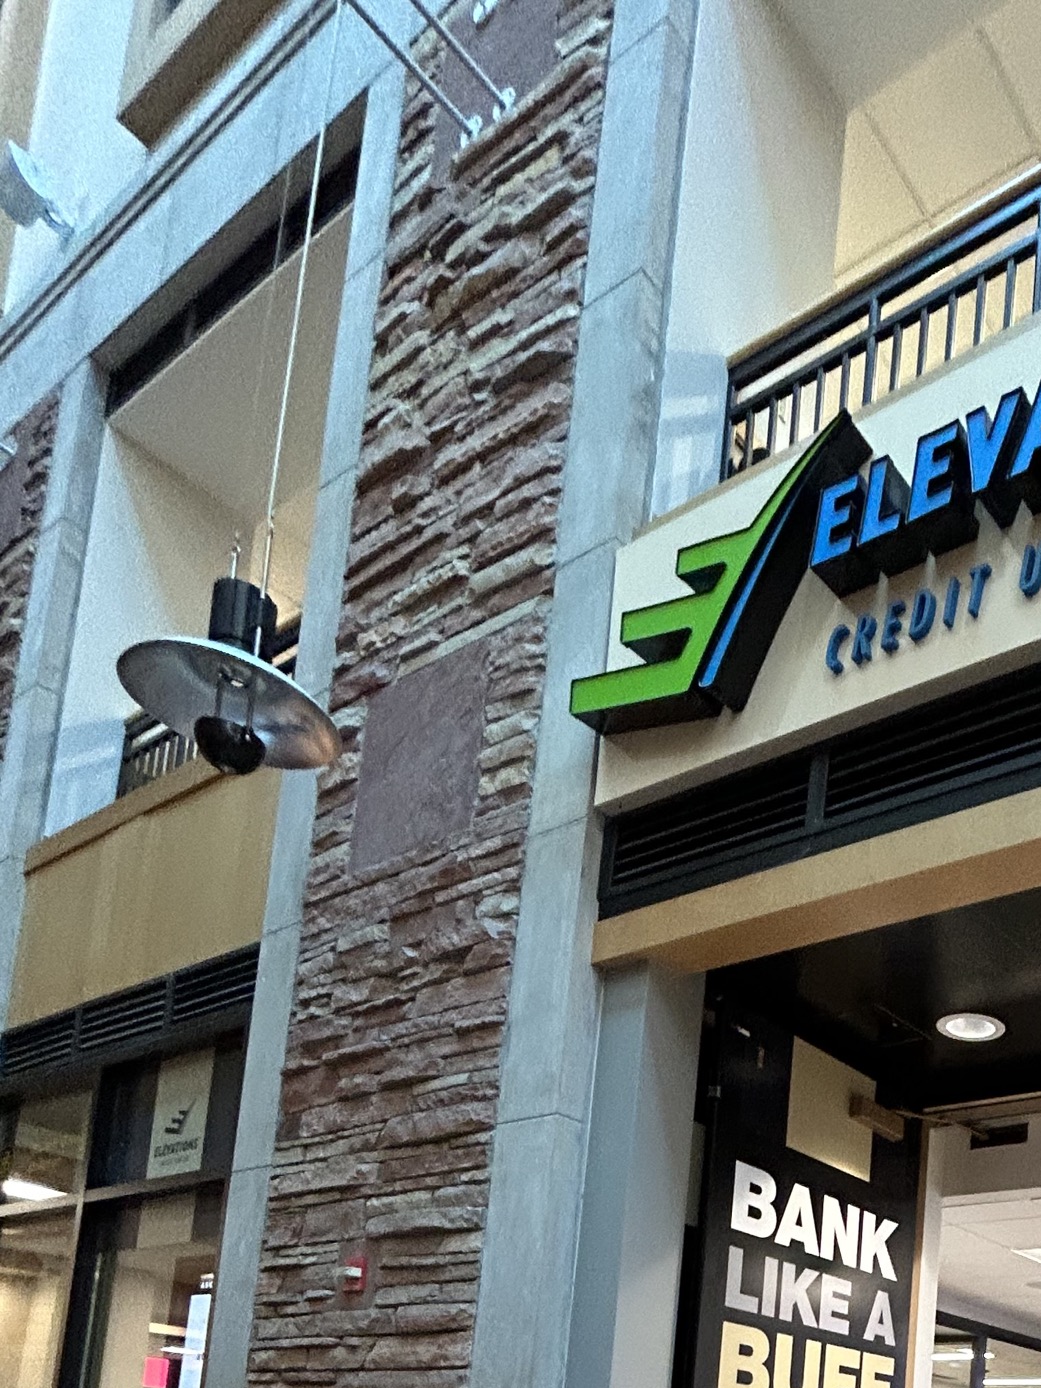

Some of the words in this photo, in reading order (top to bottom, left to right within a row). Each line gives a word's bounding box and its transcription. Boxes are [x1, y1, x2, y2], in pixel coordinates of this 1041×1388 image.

[825, 563, 992, 675] CREDIT
[731, 1159, 899, 1282] BANK
[725, 1245, 852, 1336] LIKE
[862, 1289, 896, 1347] A
